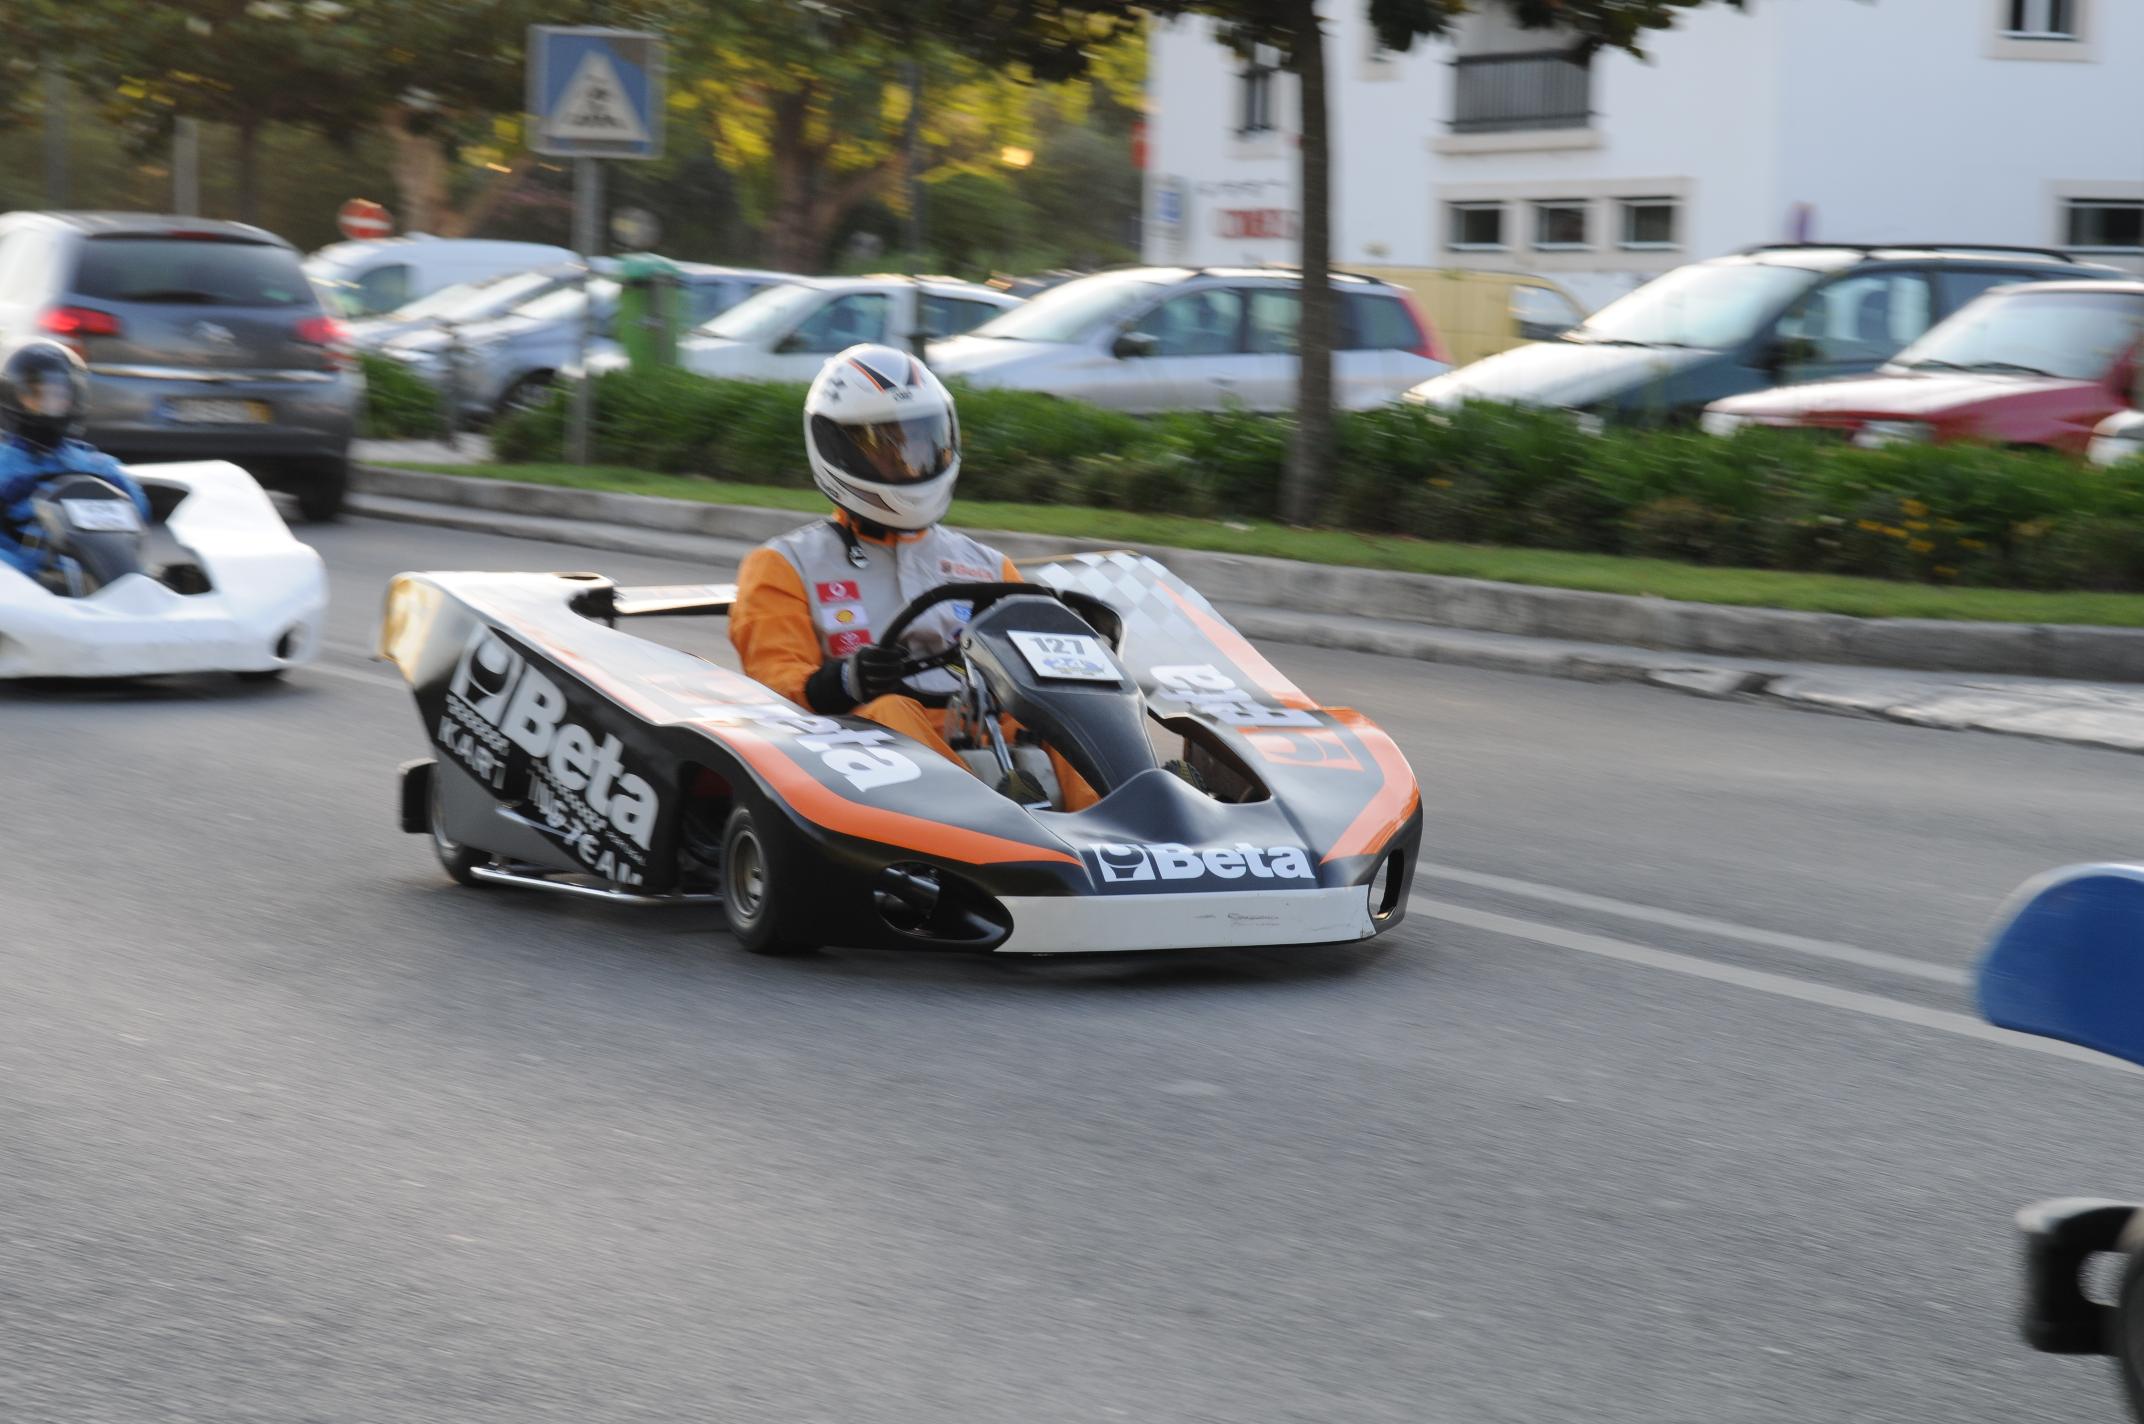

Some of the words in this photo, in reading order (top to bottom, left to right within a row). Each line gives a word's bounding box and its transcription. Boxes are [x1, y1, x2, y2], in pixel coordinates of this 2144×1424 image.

[1029, 637, 1086, 655] 127
[499, 662, 659, 851] Beta
[1142, 842, 1316, 879] Beta
